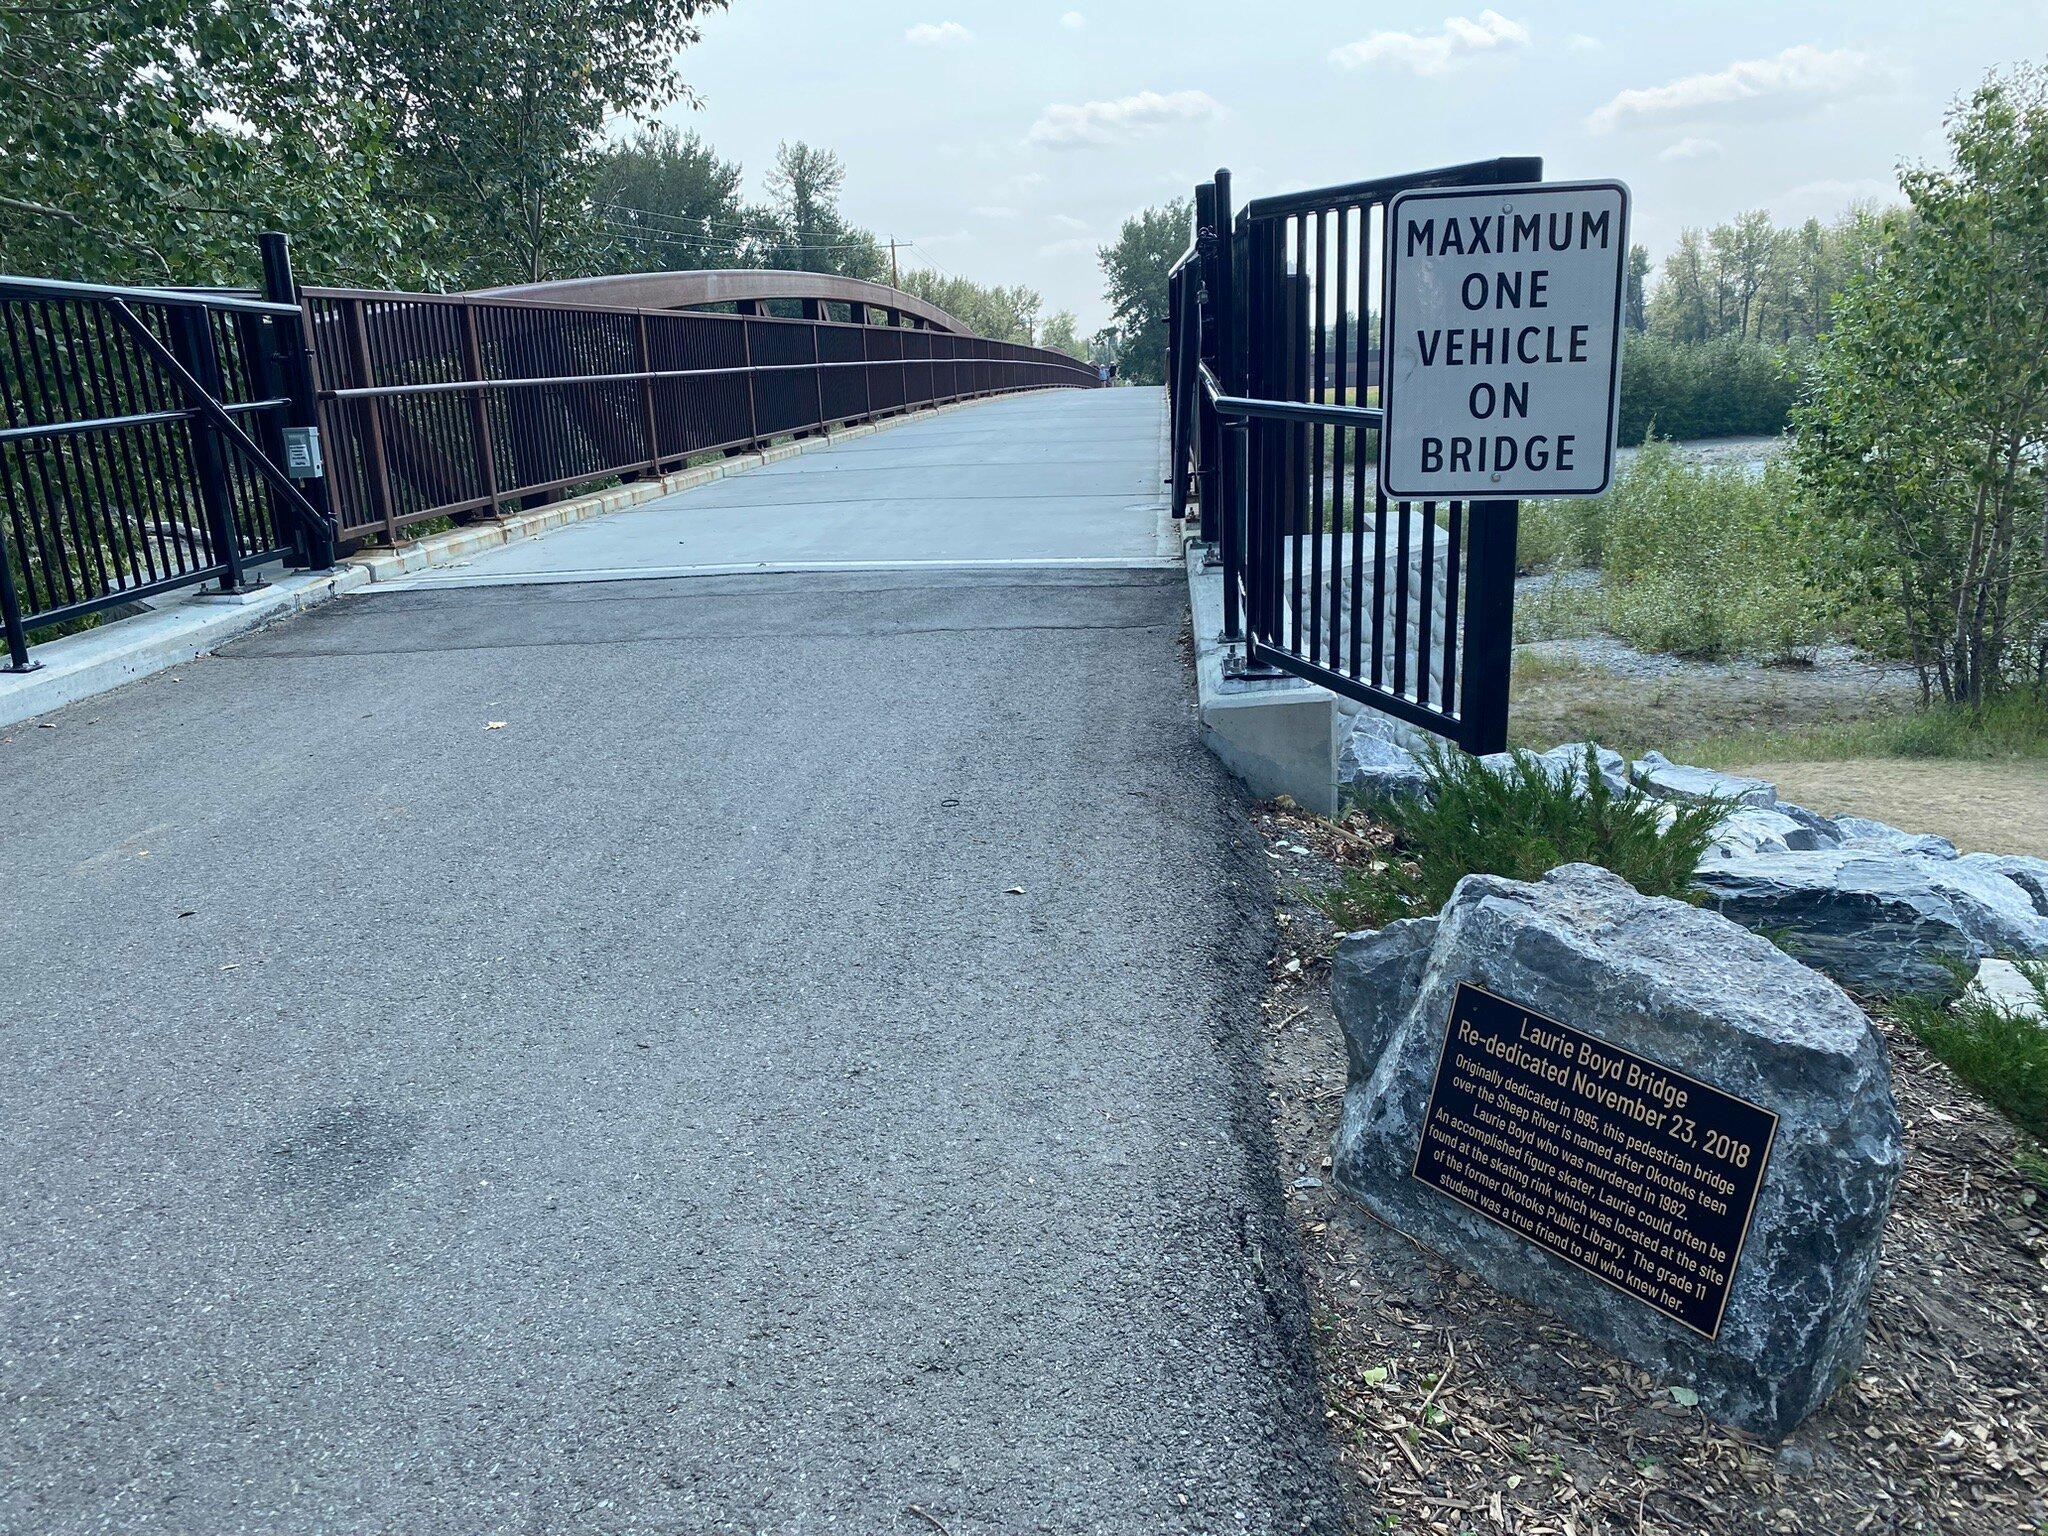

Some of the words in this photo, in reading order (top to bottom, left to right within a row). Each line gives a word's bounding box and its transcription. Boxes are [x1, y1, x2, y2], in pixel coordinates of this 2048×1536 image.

[1407, 210, 1610, 257] MAXIMUM
[1461, 270, 1549, 311] ONE
[1417, 324, 1589, 367] VEHICLE
[1468, 381, 1529, 420] ON
[1421, 435, 1576, 474] BRIDGE
[1456, 1053, 1504, 1089] Originally
[1504, 1077, 1558, 1113] dedicated
[1559, 1101, 1571, 1119] in
[1573, 1107, 1599, 1133] 1995,
[1602, 1122, 1625, 1143] this
[1626, 1135, 1692, 1175] pedestrian
[1694, 1163, 1735, 1195] bridge
[1458, 1019, 1571, 1088] Re-dedicated
[1572, 1070, 1667, 1130] November
[1668, 1114, 1698, 1148] 23,
[1702, 1129, 1751, 1168] 2018
[1519, 1018, 1575, 1059] Laurie
[1578, 1043, 1624, 1081] Boyd
[1626, 1063, 1688, 1109] Bridge
[1429, 1124, 1458, 1149] found
[1459, 1141, 1469, 1156] at
[1471, 1145, 1489, 1165] the
[1490, 1157, 1530, 1188] skating
[1530, 1178, 1552, 1198] rink
[1554, 1189, 1587, 1216] which
[1589, 1207, 1612, 1229] was
[1613, 1218, 1660, 1253] located
[1660, 1244, 1674, 1261] at
[1676, 1251, 1697, 1272] the
[1699, 1265, 1724, 1286] site
[1435, 1107, 1450, 1124] An
[1450, 1116, 1523, 1161] accomplished
[1523, 1150, 1556, 1177] figure
[1557, 1168, 1596, 1200] skater,
[1598, 1187, 1636, 1217] Laurie
[1637, 1211, 1672, 1236] could
[1673, 1228, 1707, 1254] often
[1709, 1243, 1726, 1263] be
[1453, 1076, 1477, 1095] over
[1477, 1084, 1495, 1104] the
[1496, 1094, 1530, 1122] Sheep
[1531, 1110, 1561, 1136] River
[1561, 1124, 1571, 1141] is
[1573, 1135, 1613, 1160] named
[1613, 1152, 1645, 1175] after
[1645, 1165, 1696, 1201] Okotoks
[1698, 1190, 1728, 1216] teen
[1473, 1103, 1506, 1131] Laurie
[1507, 1120, 1536, 1145] Boyd
[1537, 1136, 1559, 1157] who
[1561, 1149, 1584, 1169] was
[1585, 1161, 1644, 1199] murdered
[1644, 1187, 1656, 1205] in
[1658, 1193, 1688, 1221] 1982.
[1433, 1150, 1446, 1164] of
[1447, 1153, 1463, 1172] the
[1464, 1163, 1501, 1192] former
[1501, 1182, 1545, 1216] Okotoks
[1546, 1205, 1581, 1234] Public
[1582, 1224, 1626, 1260] Library.
[1633, 1250, 1655, 1273] The
[1656, 1266, 1693, 1294] grade
[1695, 1283, 1707, 1301] 11
[1439, 1173, 1479, 1202] student
[1480, 1194, 1500, 1214] was
[1502, 1207, 1509, 1219] a
[1511, 1211, 1533, 1231] true
[1535, 1222, 1572, 1250] friend
[1571, 1240, 1582, 1258] to
[1584, 1250, 1599, 1266] all
[1600, 1258, 1624, 1280] who
[1625, 1270, 1660, 1299] knew
[1660, 1288, 1684, 1313] her.
